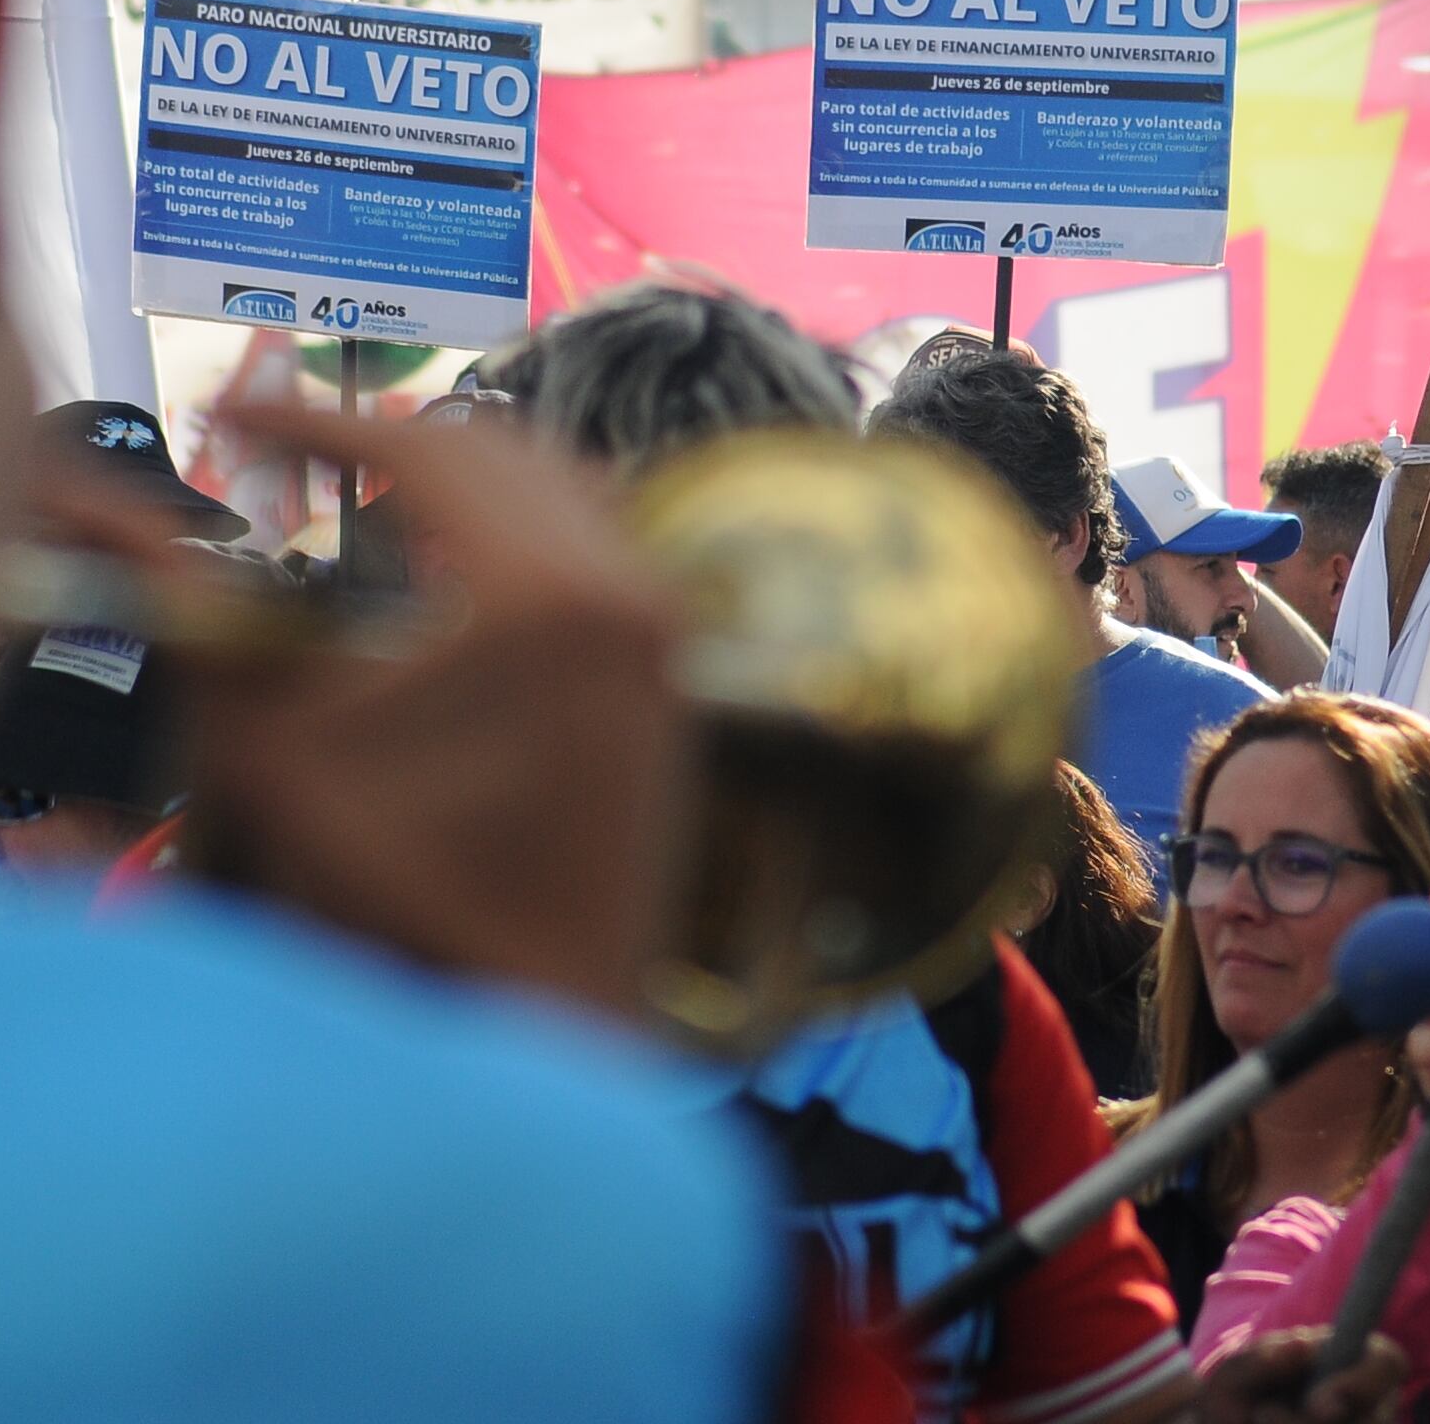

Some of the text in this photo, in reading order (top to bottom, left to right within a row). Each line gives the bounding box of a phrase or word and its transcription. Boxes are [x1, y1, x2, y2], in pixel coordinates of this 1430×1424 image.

[197, 3, 491, 51] PARO NACIONAL UNIVERSITARIO
[835, 36, 1216, 64] DE LA LEY DE FINANCIAMIENTO UNIVERSITARIO
[151, 25, 531, 118] NO AL VETO
[931, 75, 1110, 95] Jueves 26 de septiembre
[157, 98, 516, 151] DE LA LEY DE FINANCIAMIENTO UNIVERSITARIO
[821, 101, 1011, 121] Paro total de actividades
[1036, 111, 1223, 131] Banderazo y volanteada
[832, 120, 998, 138] sin concurrencia a los
[1124, 129, 1151, 140] horas
[245, 144, 415, 176] Jueves 26 de septiembre
[844, 138, 984, 159] lugares de trabajo
[1087, 140, 1100, 149] En
[1101, 141, 1129, 151] Sedes
[144, 161, 320, 195] Paro total de actividades
[819, 171, 1219, 197] Invitamos a toda la Comunidad a sumarse en defensa de la Universidad Pública
[154, 180, 308, 211] sin concurrencia a los
[344, 187, 522, 219] Banderazo y volanteada
[165, 198, 295, 229] lugares de trabajo
[1000, 223, 1054, 255] 40
[1056, 223, 1101, 239] AÑOS
[143, 230, 519, 286] Invitamos a toda la Comunidad a sumarse en defensa de la Universidad Pública
[310, 295, 361, 330] 40
[363, 300, 407, 318] AÑOS
